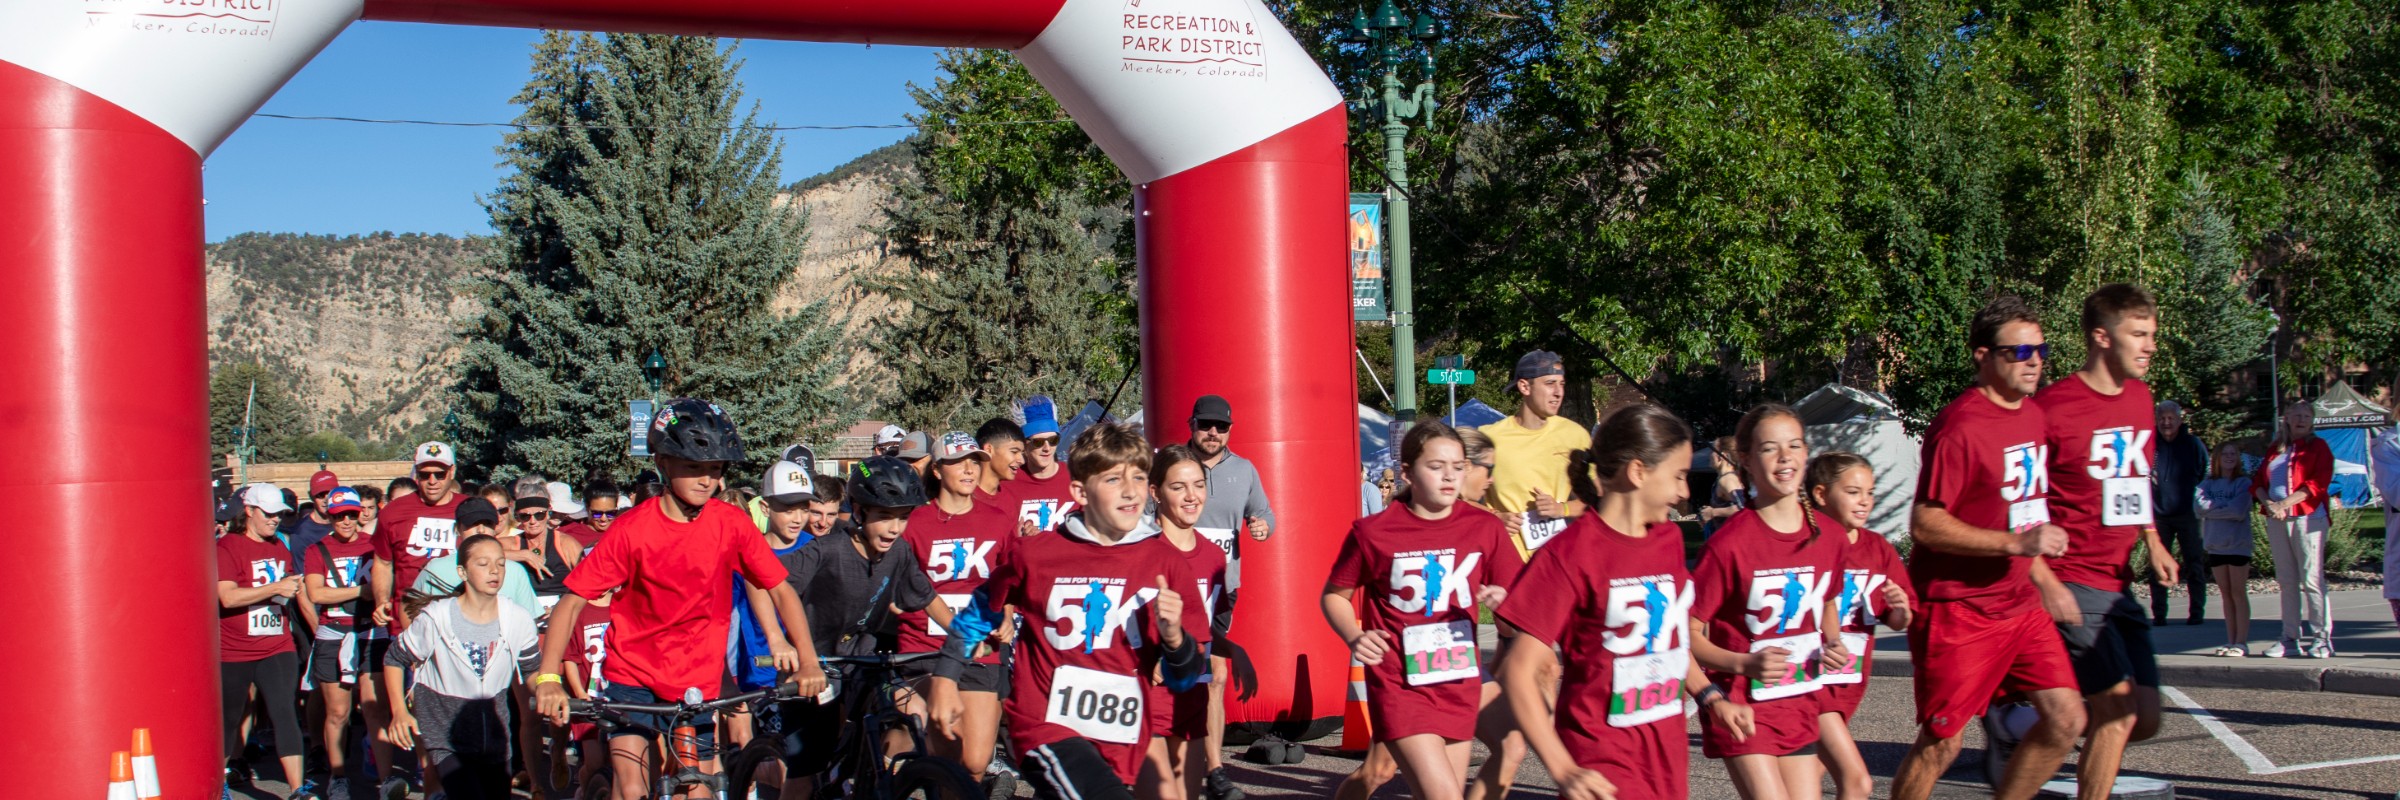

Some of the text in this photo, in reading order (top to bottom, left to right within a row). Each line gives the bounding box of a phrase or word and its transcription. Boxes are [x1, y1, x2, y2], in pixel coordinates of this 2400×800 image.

[186, 22, 269, 37] Colorado
[1123, 14, 1254, 36] RECREATION &
[1122, 35, 1262, 57] PARK DISTRICT
[1121, 62, 1264, 78] Meeker, Colorado
[1353, 298, 1376, 307] EKER
[1440, 371, 1463, 382] 5TH ST
[2086, 429, 2152, 480] 5K
[2000, 444, 2049, 502] 5K
[1018, 501, 1076, 532] 5K
[2114, 493, 2142, 516] 919
[423, 527, 449, 543] 941
[1530, 520, 1561, 540] 892
[926, 540, 997, 583] 5K
[1388, 552, 1483, 614] 5K
[1043, 584, 1160, 651] 5K
[1601, 579, 1696, 655] 5K
[1744, 571, 1833, 636] 5K
[251, 614, 282, 628] 1089
[1414, 645, 1470, 675] 145
[1058, 685, 1139, 727] 1088
[1622, 678, 1681, 714] 160
